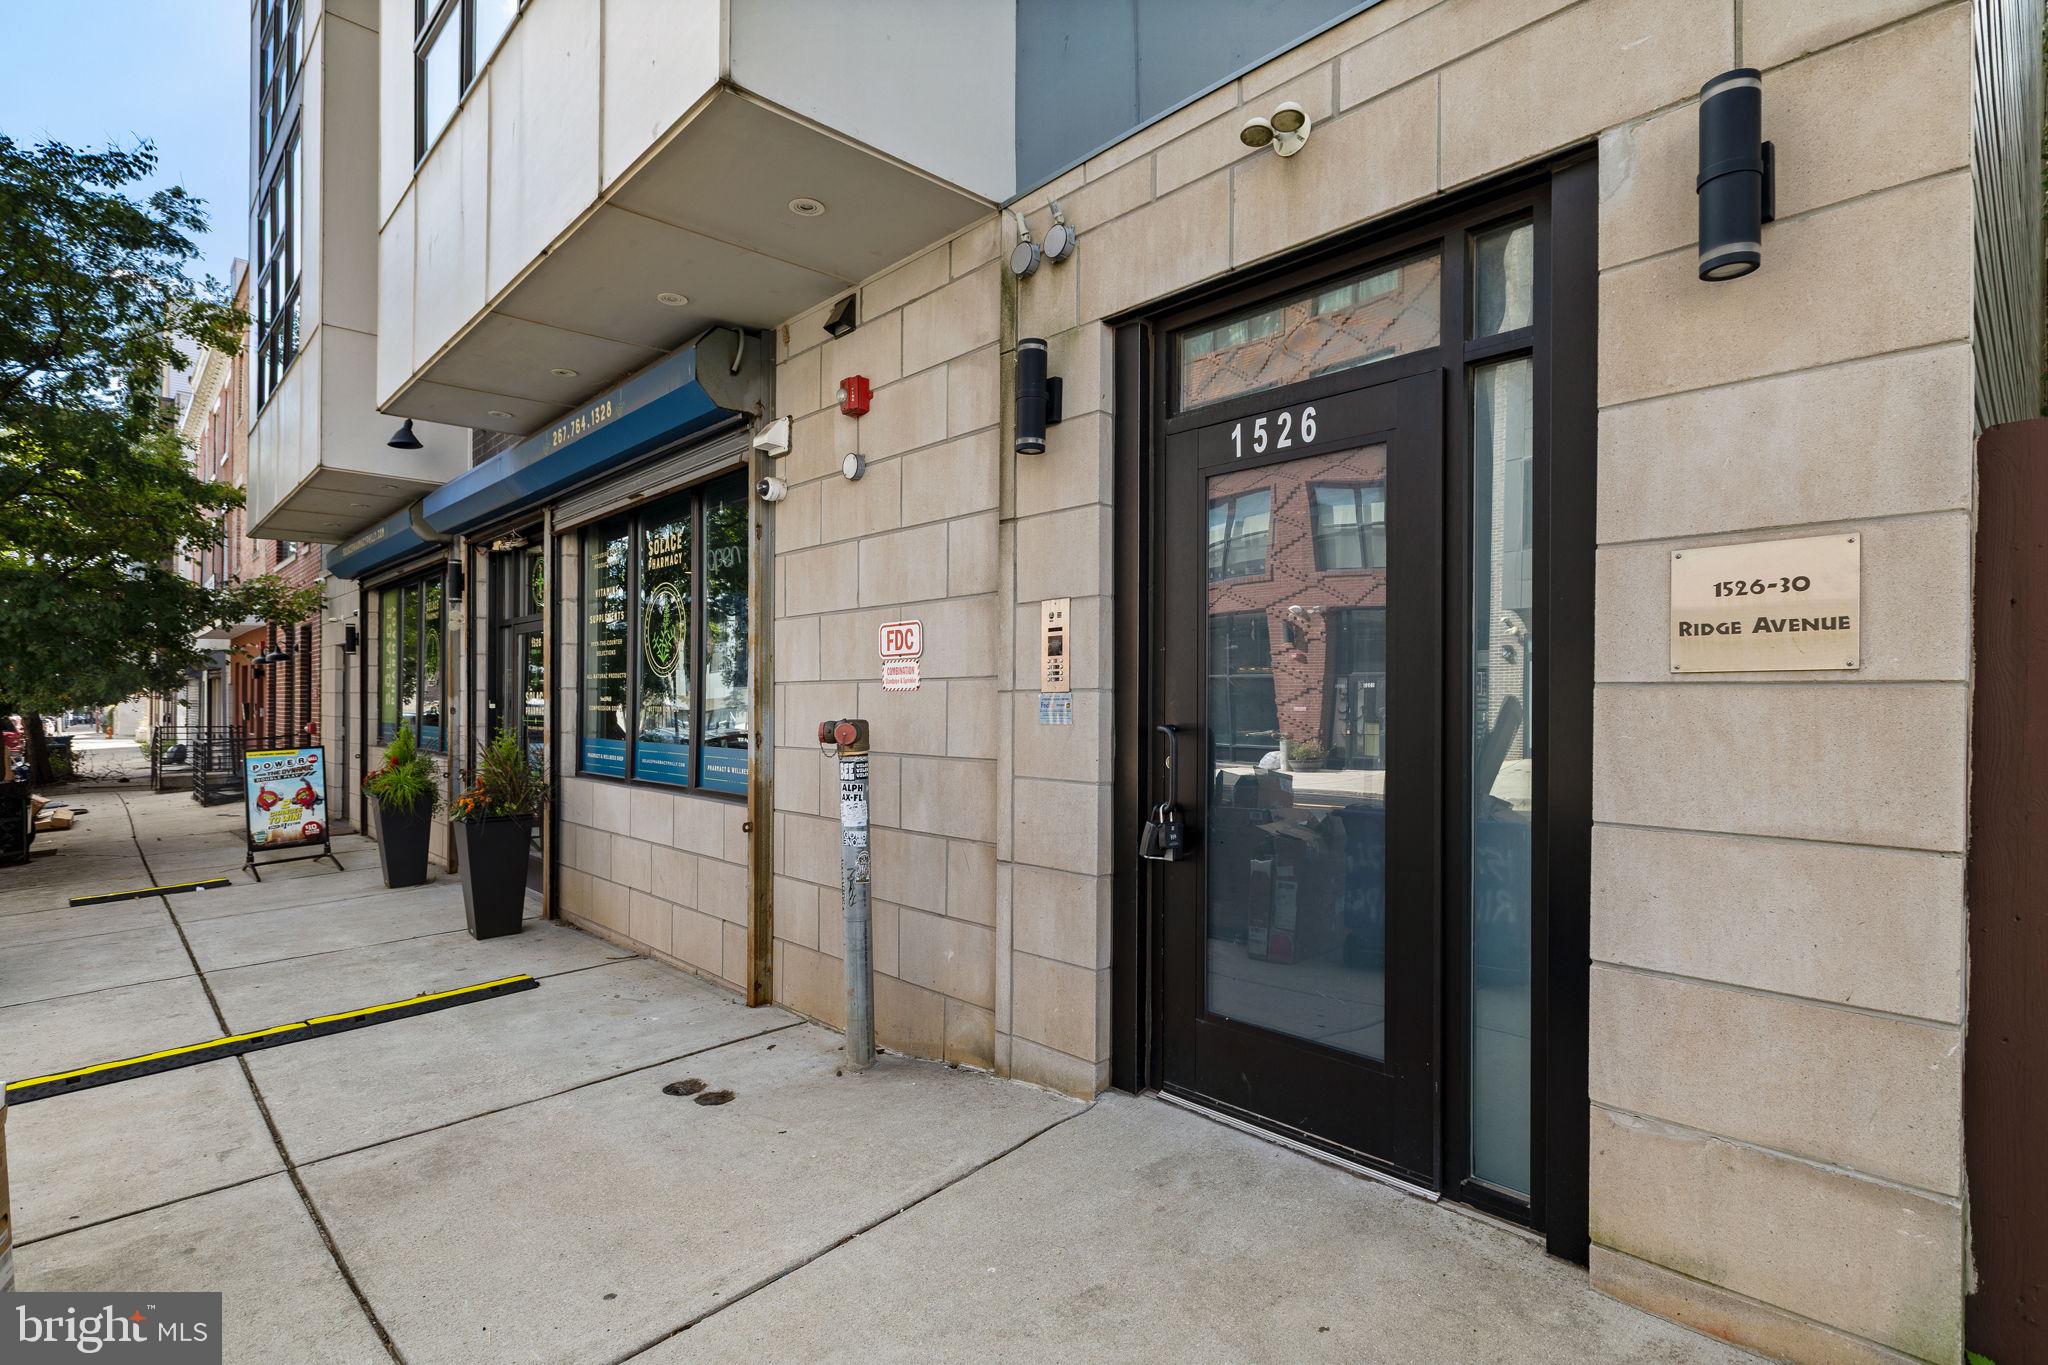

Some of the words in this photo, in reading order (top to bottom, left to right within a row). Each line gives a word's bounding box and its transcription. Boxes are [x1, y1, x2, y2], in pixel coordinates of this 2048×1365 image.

[552, 400, 612, 446] 267.764.1328
[1232, 406, 1316, 457] 1526
[648, 553, 682, 570] PHARMACY
[594, 585, 618, 598] VITAMINS
[1713, 576, 1810, 598] 1526-30
[589, 611, 625, 624] SUPPLEMENTS
[886, 628, 914, 651] FDC
[887, 666, 914, 675] COMBINATION
